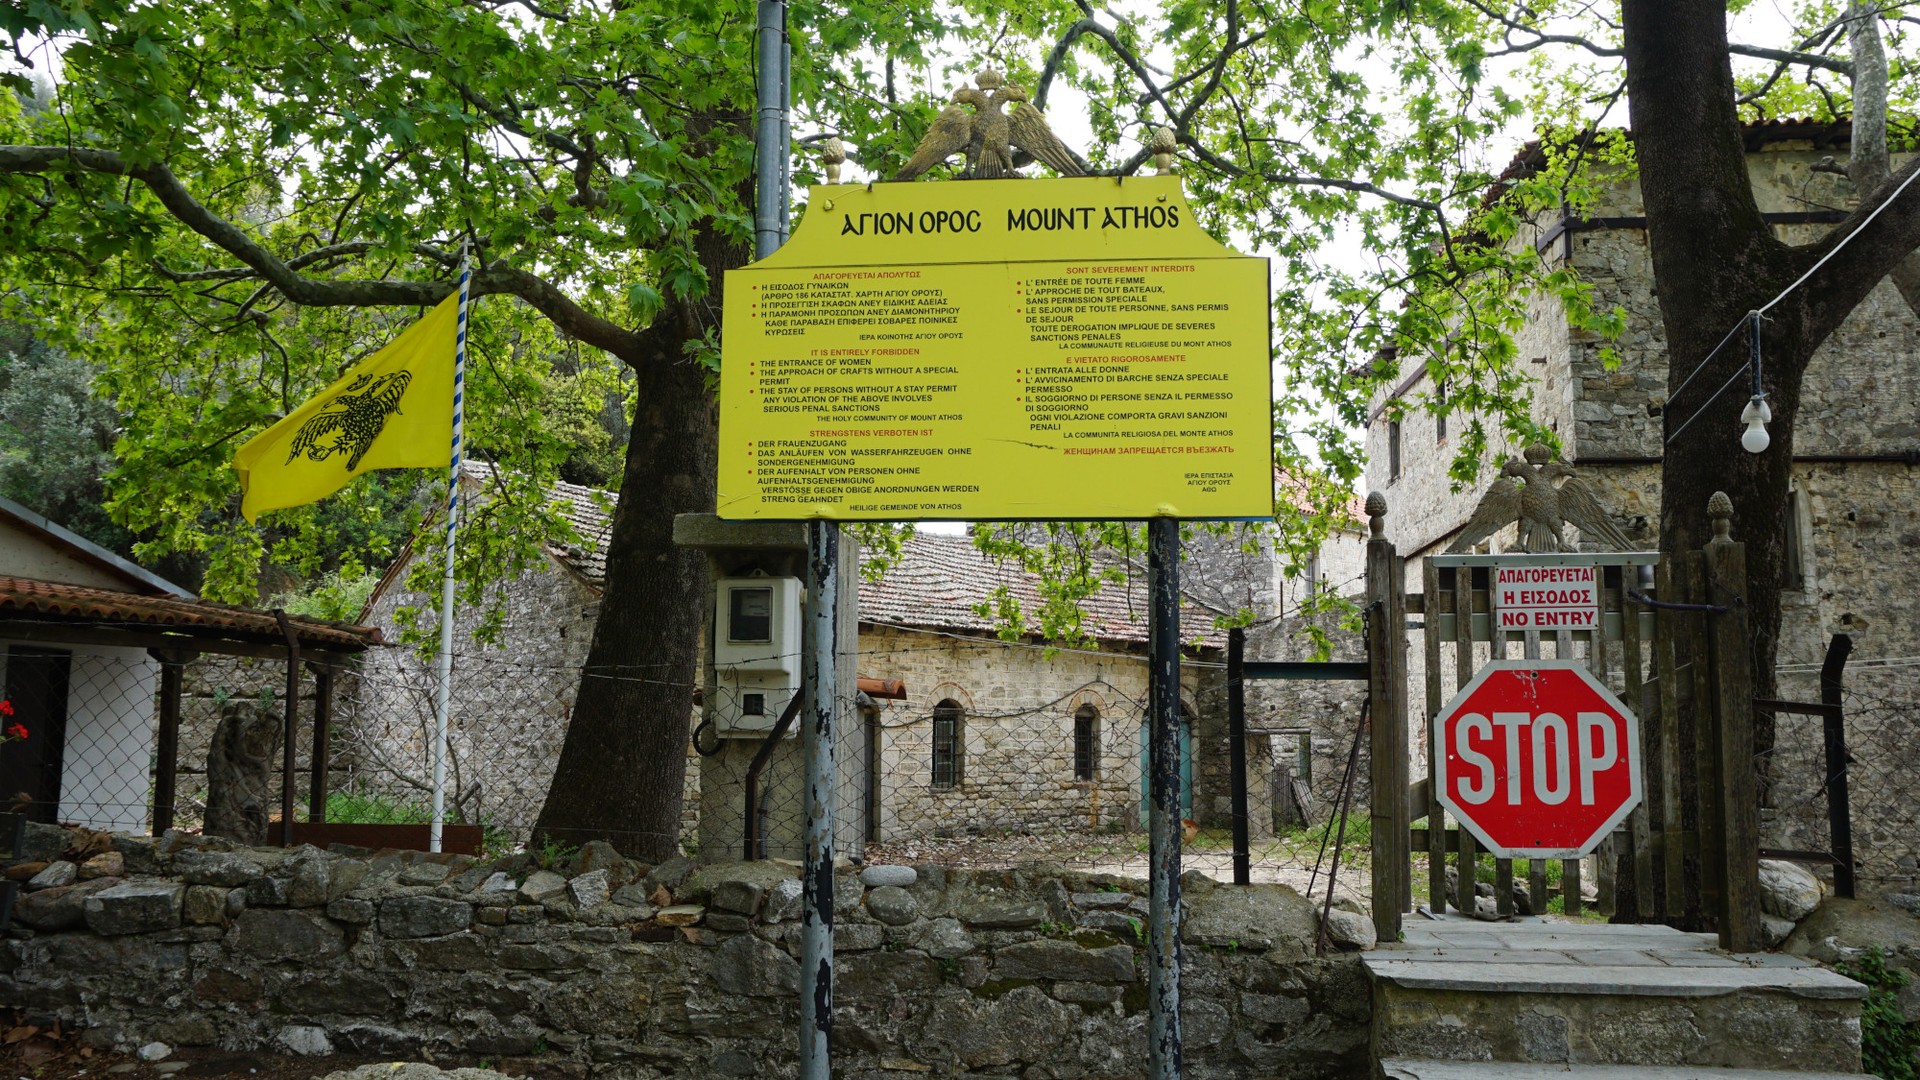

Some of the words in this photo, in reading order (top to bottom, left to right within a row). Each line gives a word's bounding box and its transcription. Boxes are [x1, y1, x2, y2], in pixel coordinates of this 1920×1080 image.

[841, 212, 913, 236] ΑΓΙΟΝ
[1008, 207, 1096, 231] MOUNT
[1101, 205, 1179, 229] ATHOS
[1061, 324, 1116, 332] DEROGATION
[1118, 446, 1184, 455] ЗАПРЕЩАЕТСЯ
[761, 486, 811, 494] VERSTÖSSE
[1499, 568, 1594, 583] ΑΠΑΓΟΡΕΥΕΤΑΙ
[1504, 591, 1514, 604] Η
[1521, 590, 1591, 604] ΕΙΣΟΔΟΣ
[1502, 612, 1528, 626] NO
[1535, 611, 1594, 625] ENTRY
[1455, 712, 1618, 805] STOP
